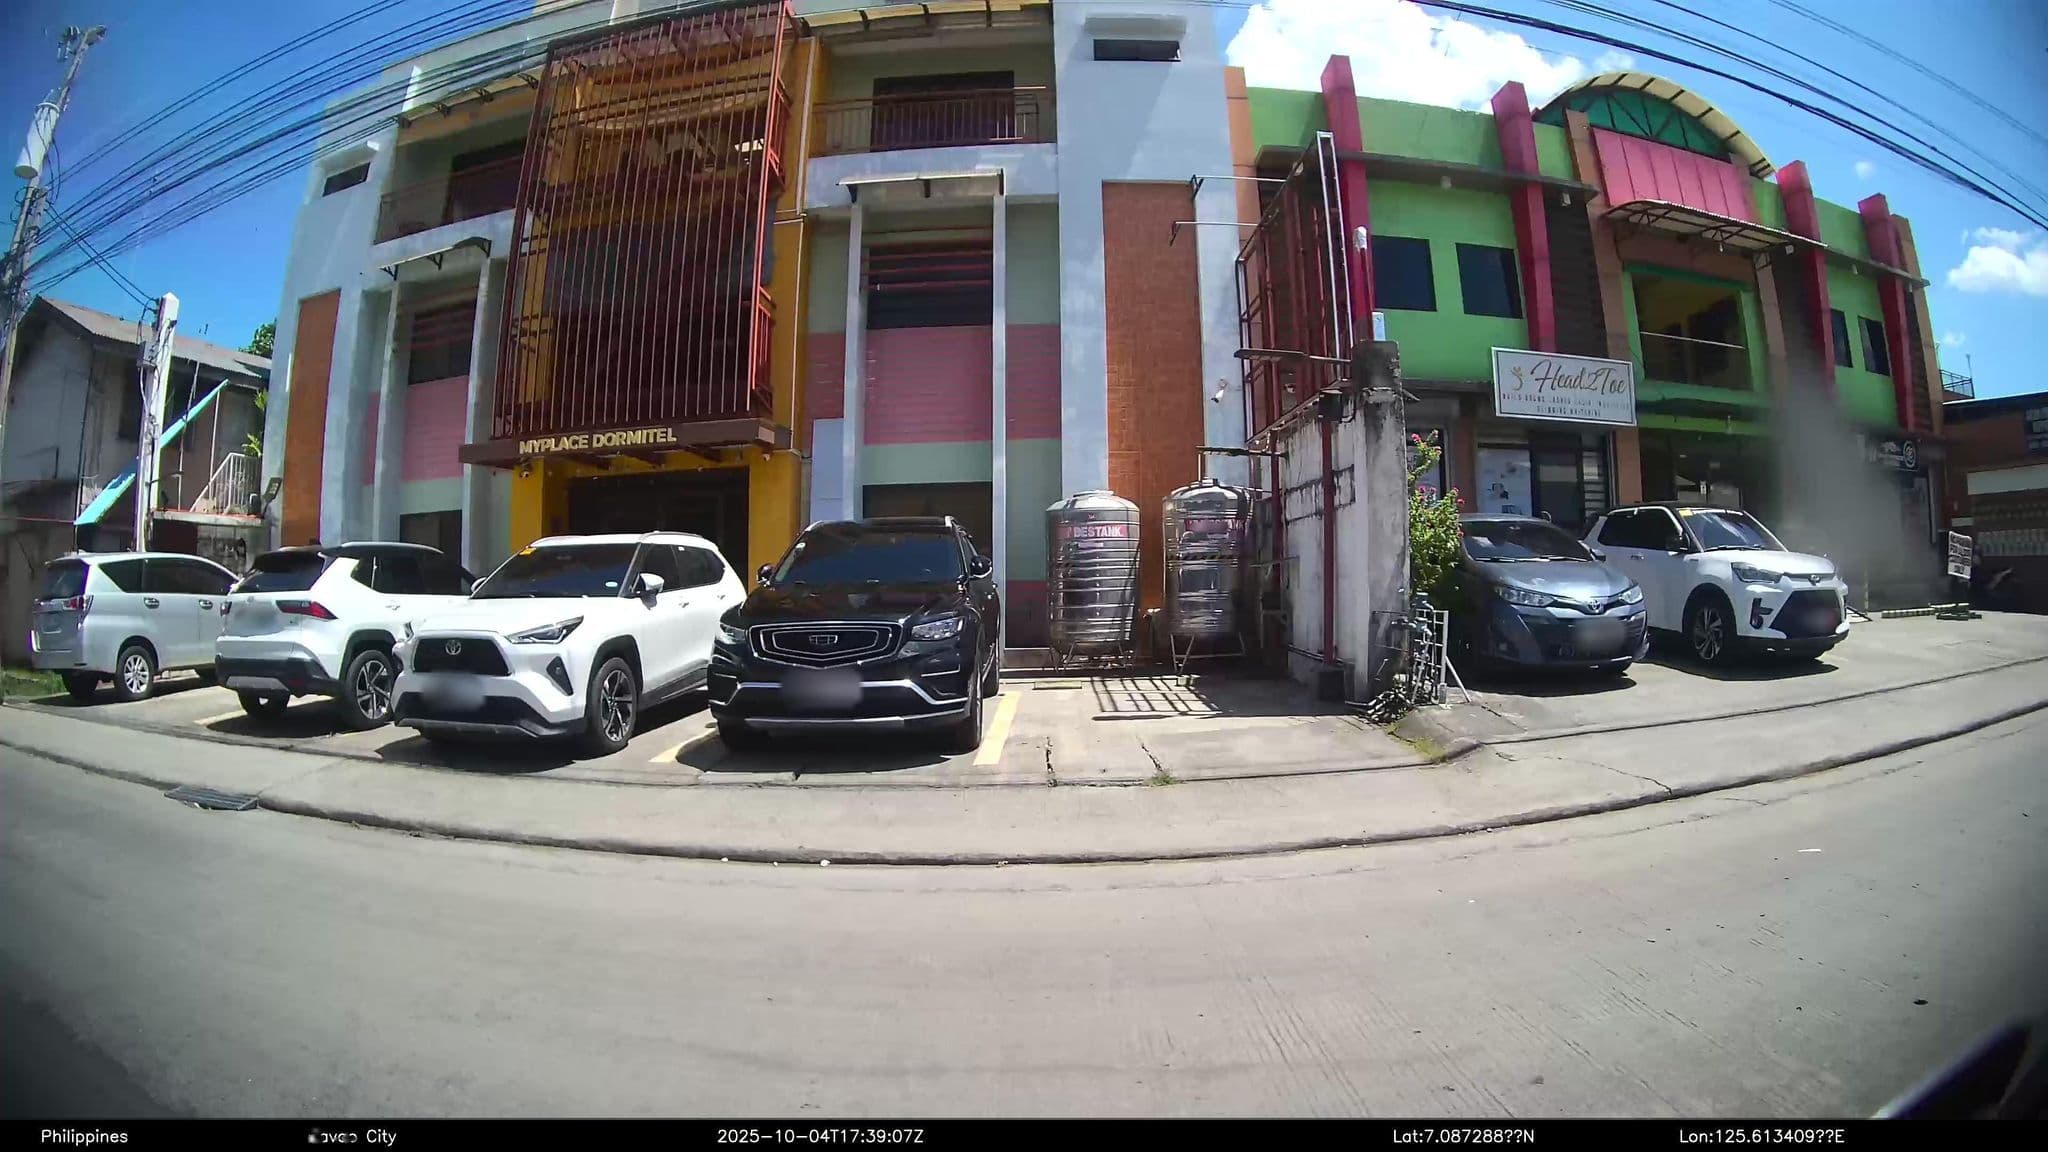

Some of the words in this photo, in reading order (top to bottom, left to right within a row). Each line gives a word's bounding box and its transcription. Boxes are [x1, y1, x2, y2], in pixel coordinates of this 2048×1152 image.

[1530, 359, 1626, 396] Head2Toe
[519, 434, 588, 455] MYPLACE
[593, 427, 677, 449] DORMITEL
